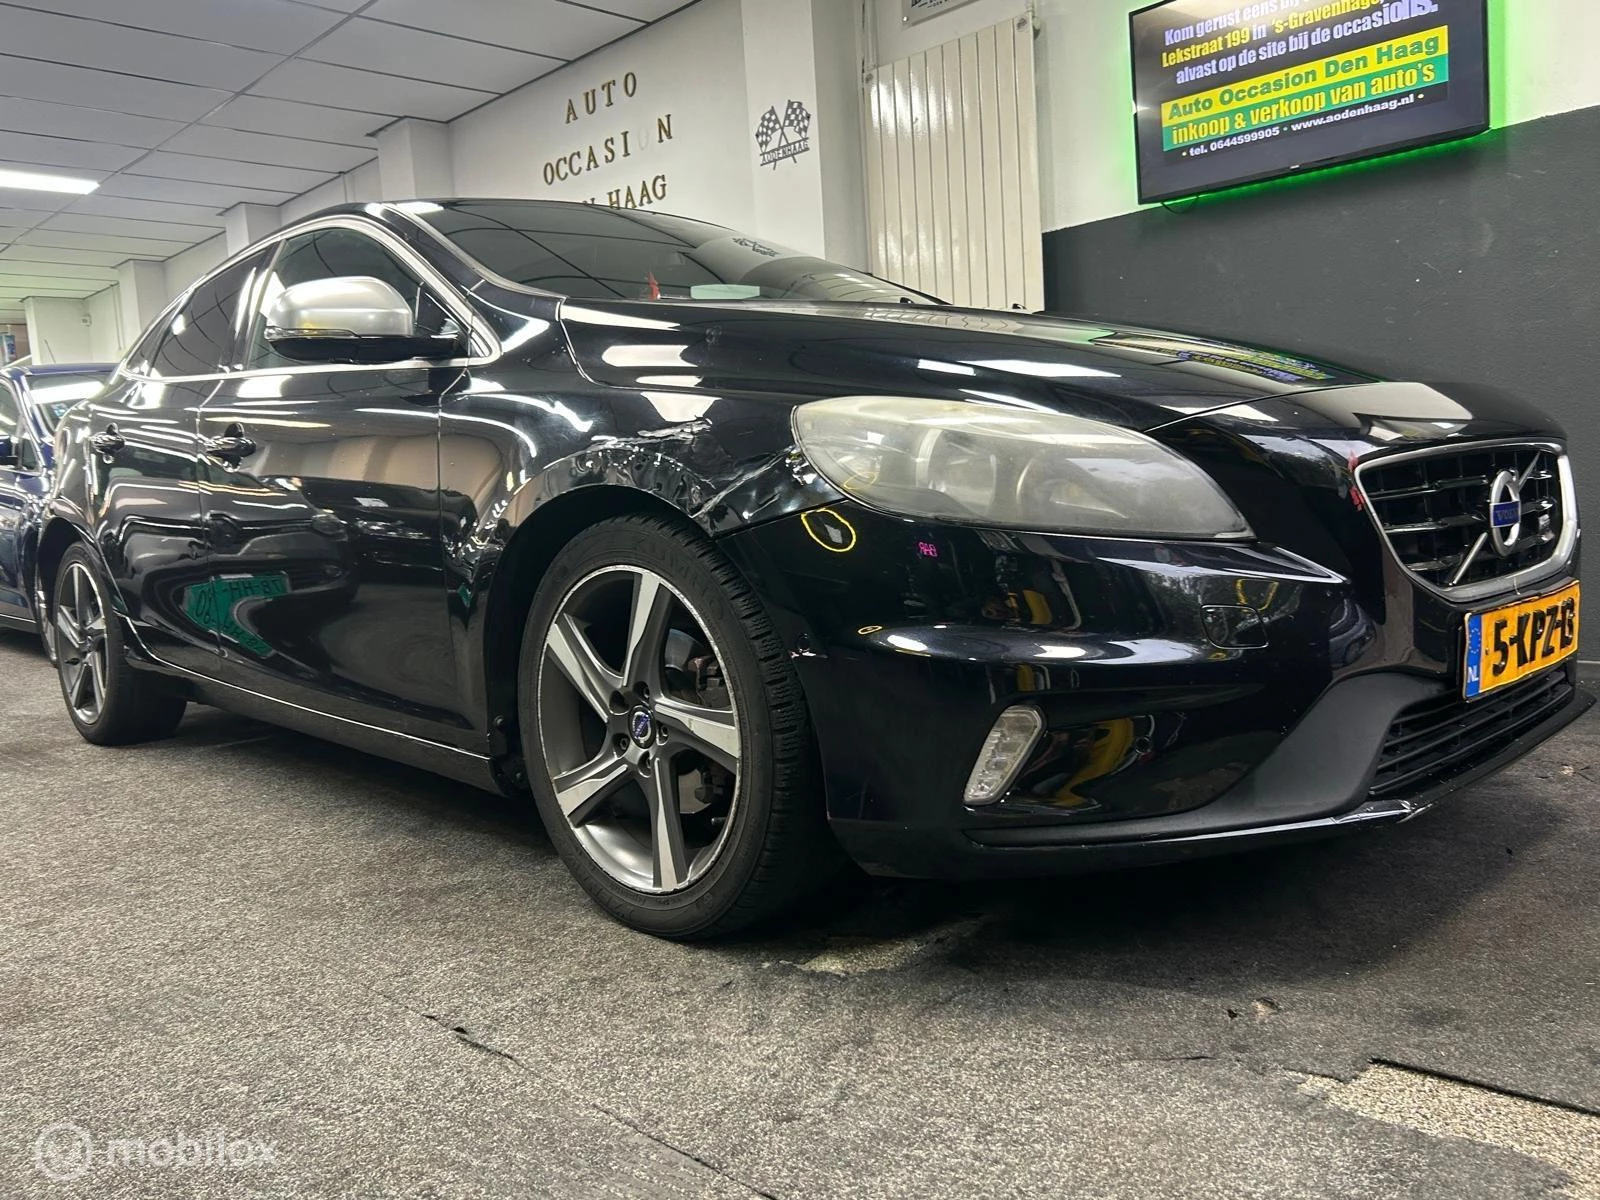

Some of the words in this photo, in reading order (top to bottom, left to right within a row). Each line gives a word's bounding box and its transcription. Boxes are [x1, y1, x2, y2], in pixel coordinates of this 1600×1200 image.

[1161, 38, 1224, 68] Lekstraat
[1225, 27, 1250, 49] 199
[1252, 24, 1267, 41] in
[1164, 26, 1194, 46] Kom
[1196, 12, 1240, 38] gerust
[1243, 0, 1278, 21] eens
[1168, 97, 1214, 120] Auto
[1219, 68, 1317, 106] Occasion
[1324, 55, 1368, 78] Den
[1376, 35, 1439, 65] Haag
[1176, 60, 1217, 85] alvast
[1218, 55, 1237, 72] op
[1238, 49, 1257, 67] de
[1258, 40, 1287, 61] site
[1288, 31, 1309, 52] bij
[1310, 27, 1331, 46] de
[564, 71, 638, 125] AUTO
[1172, 115, 1230, 145] inkoop
[1234, 112, 1247, 130] &
[1250, 91, 1326, 125] verkoop
[1330, 81, 1366, 106] van
[1370, 63, 1436, 96] auto's
[1189, 144, 1208, 157] tel.
[1210, 126, 1280, 152] 0644599905
[1291, 93, 1415, 131] www.aodenhaag.nl
[606, 174, 667, 210] HAAG
[1467, 665, 1480, 684] NL
